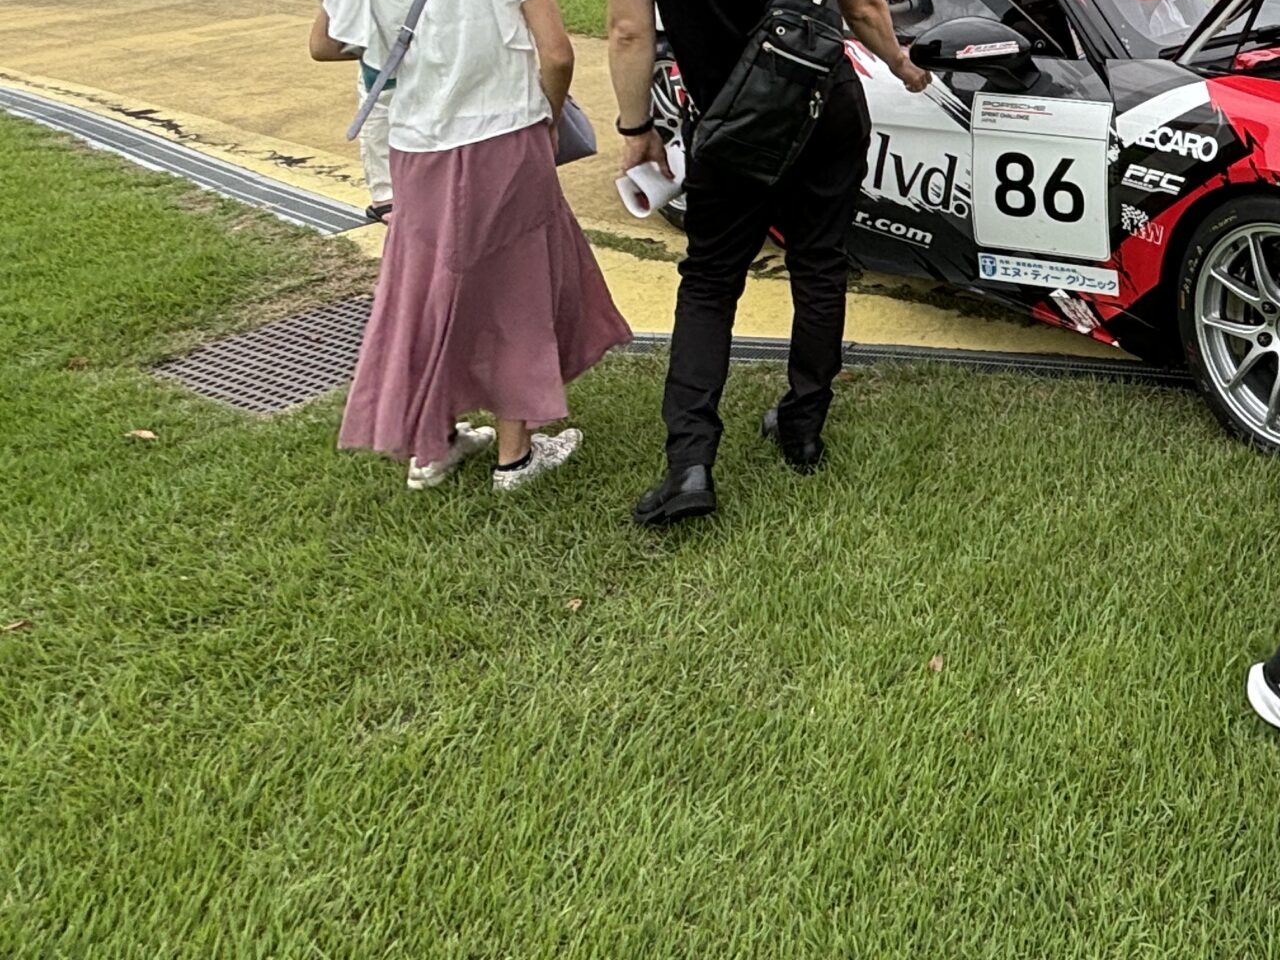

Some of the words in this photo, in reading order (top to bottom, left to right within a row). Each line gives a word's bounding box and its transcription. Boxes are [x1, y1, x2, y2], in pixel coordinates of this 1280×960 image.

[982, 100, 1046, 111] PORSCHE
[1124, 126, 1219, 162] ECARO
[873, 131, 969, 219] lvd.
[995, 151, 1085, 223] 86
[1122, 163, 1186, 192] PFC
[854, 210, 933, 244] r.com
[1000, 266, 1062, 284] エヌ・ティー
[1066, 274, 1117, 291] クリニック
